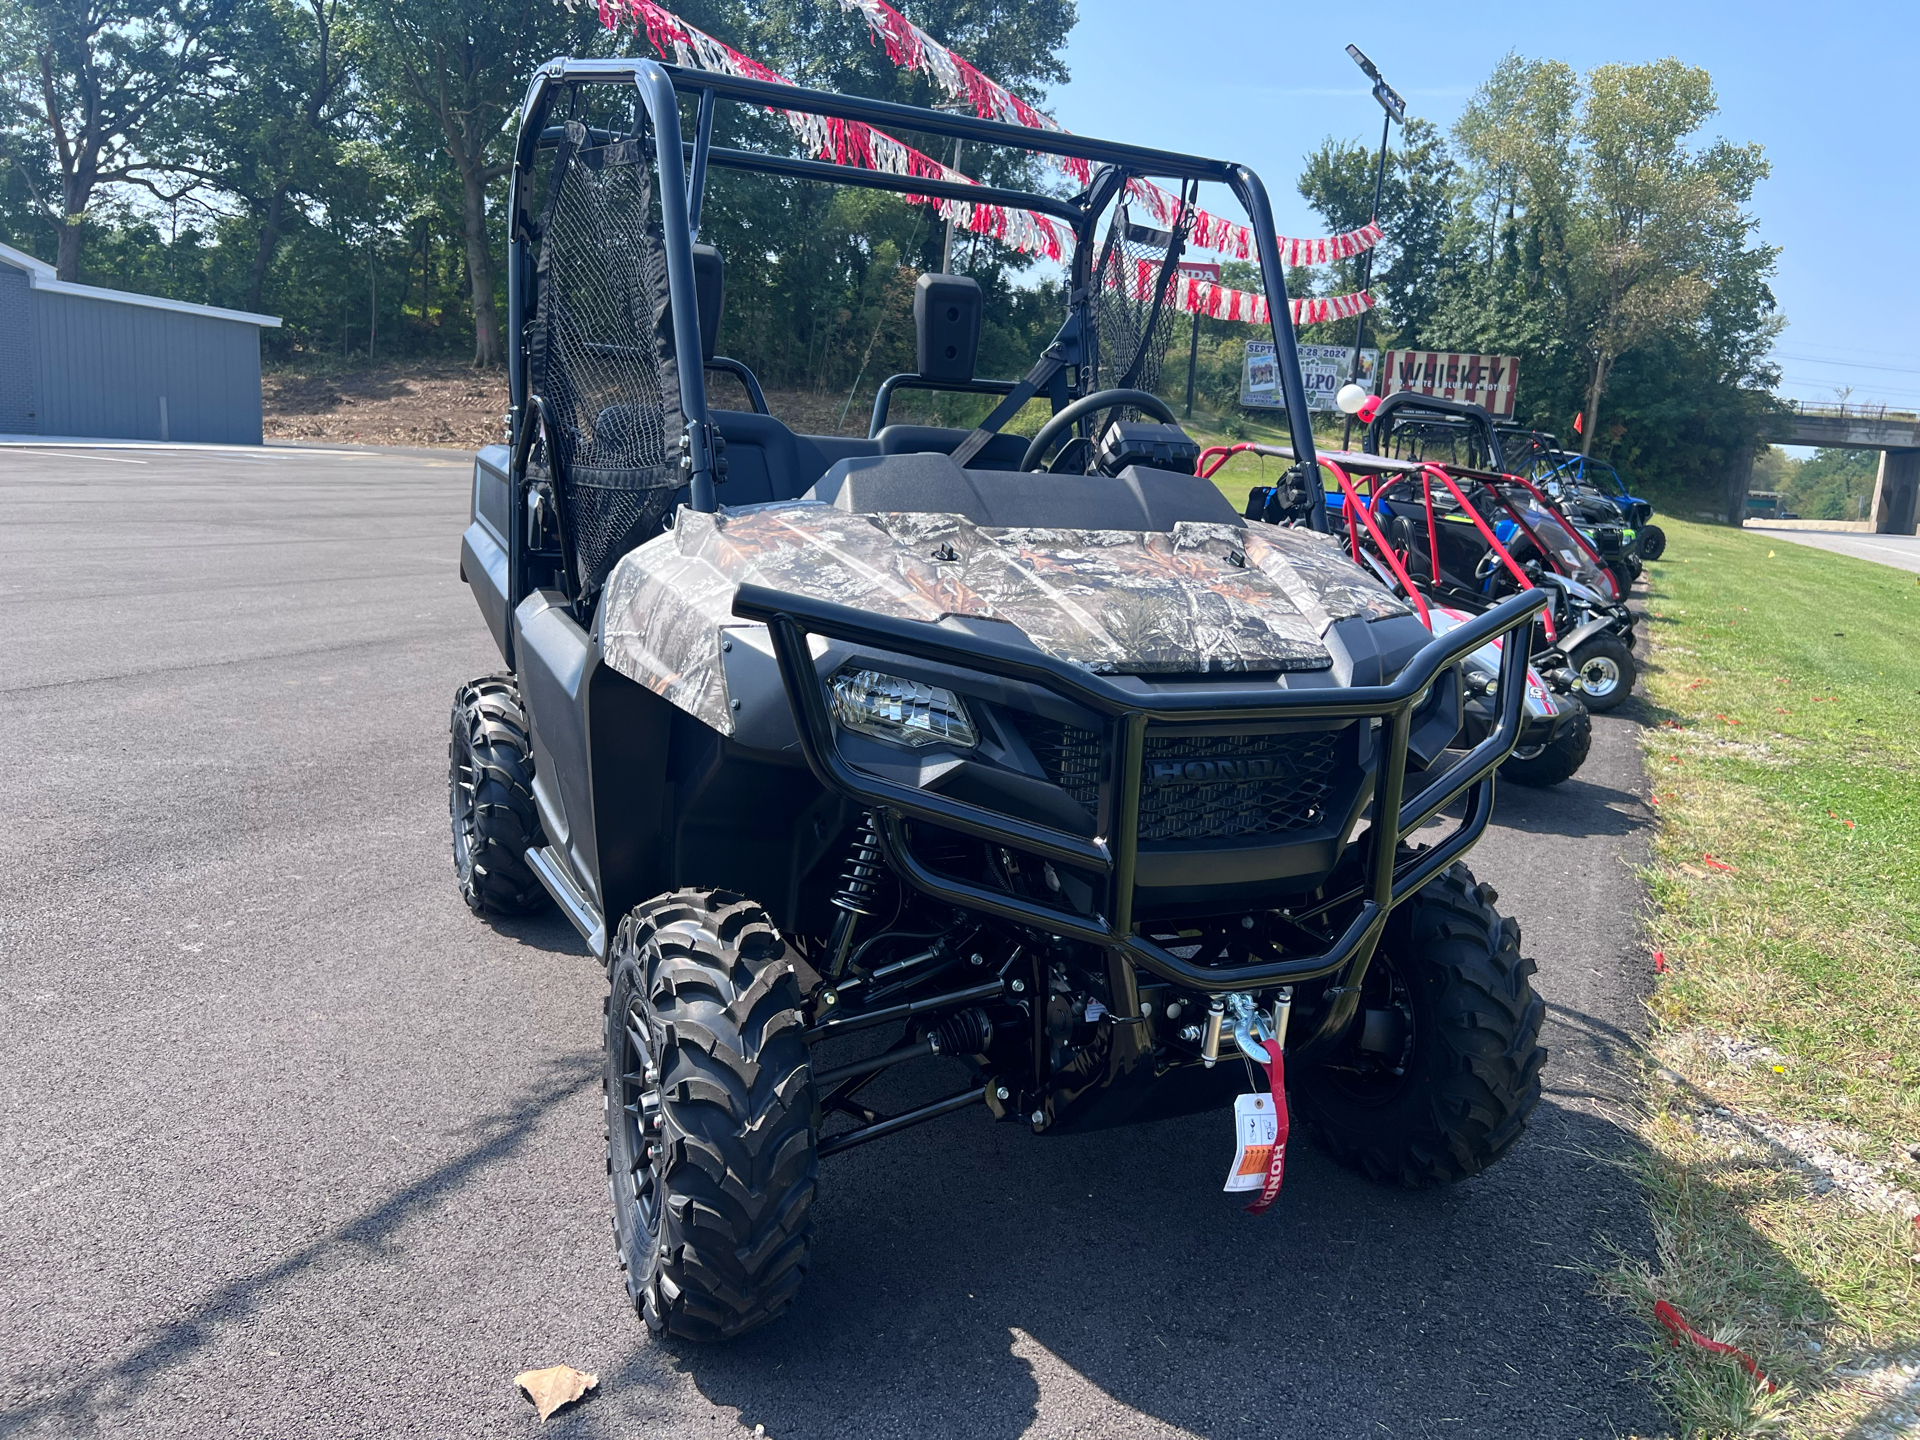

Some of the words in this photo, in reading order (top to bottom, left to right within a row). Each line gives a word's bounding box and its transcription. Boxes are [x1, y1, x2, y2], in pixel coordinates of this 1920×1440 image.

[1323, 349, 1347, 359] 2024
[1304, 373, 1335, 390] LPO
[1399, 361, 1505, 391] WHISKEY
[1388, 378, 1405, 387] RED,
[1408, 379, 1432, 388] WHITE
[1443, 380, 1462, 389] BLUE
[1465, 381, 1473, 390] IN
[1475, 382, 1480, 390] A
[1483, 382, 1512, 392] BOTTLE
[1146, 757, 1298, 784] HONDA
